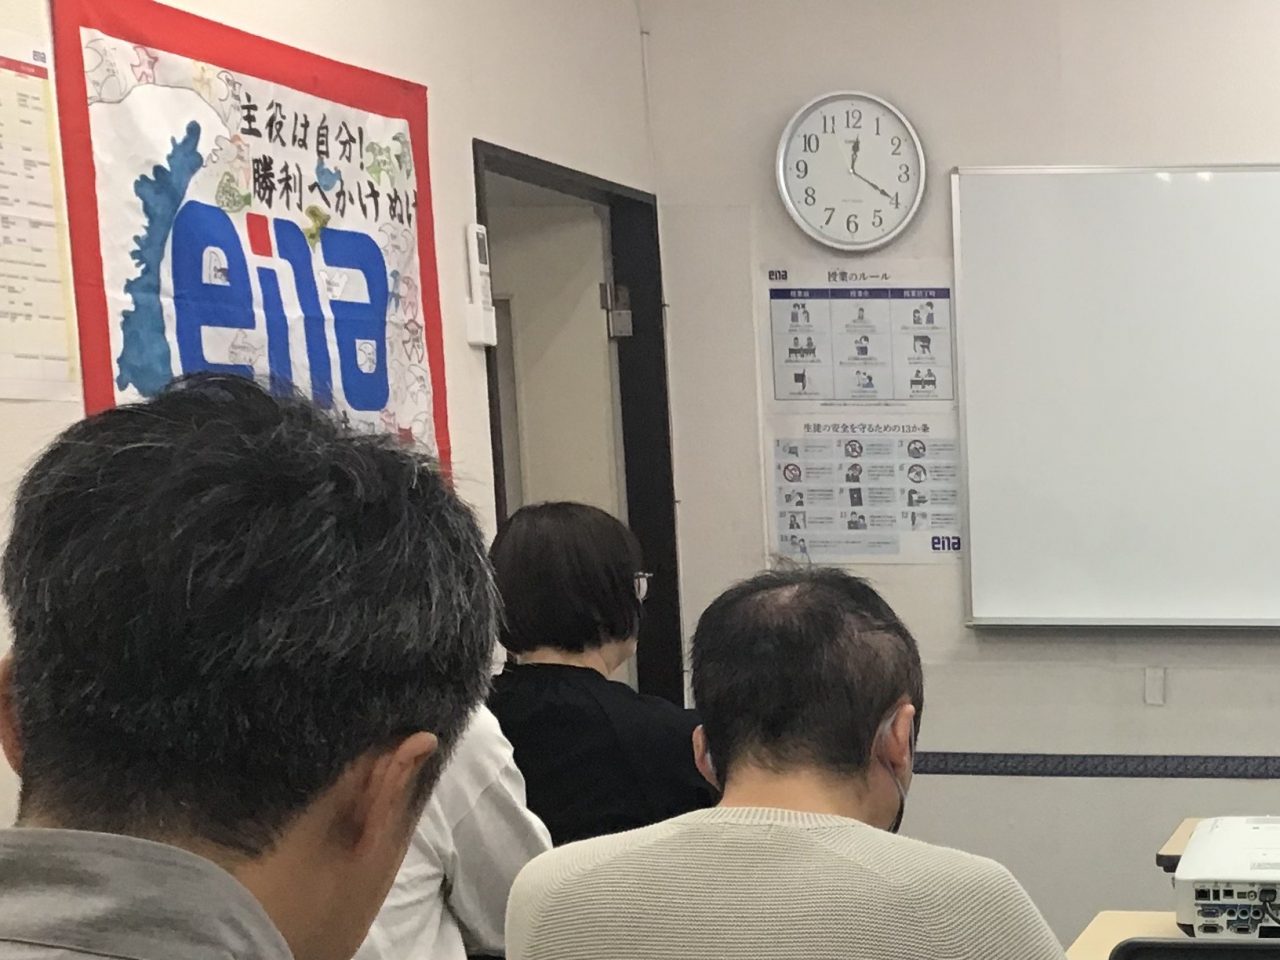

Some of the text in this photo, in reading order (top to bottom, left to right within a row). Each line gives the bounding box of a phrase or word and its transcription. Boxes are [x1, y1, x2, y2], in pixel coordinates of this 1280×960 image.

[822, 115, 836, 134] 11
[845, 109, 862, 129] 12
[875, 117, 880, 136] 1
[802, 134, 819, 153] 10
[891, 136, 901, 155] 2
[796, 159, 808, 179] 9
[898, 164, 910, 183] 3
[804, 187, 816, 206] 8
[889, 192, 901, 209] 4
[824, 207, 836, 225] 7
[846, 214, 859, 233] 6
[872, 209, 883, 228] 5
[768, 270, 788, 281] ena
[827, 271, 891, 282] 授業のルール
[171, 200, 390, 412] ena
[931, 536, 961, 551] ena
